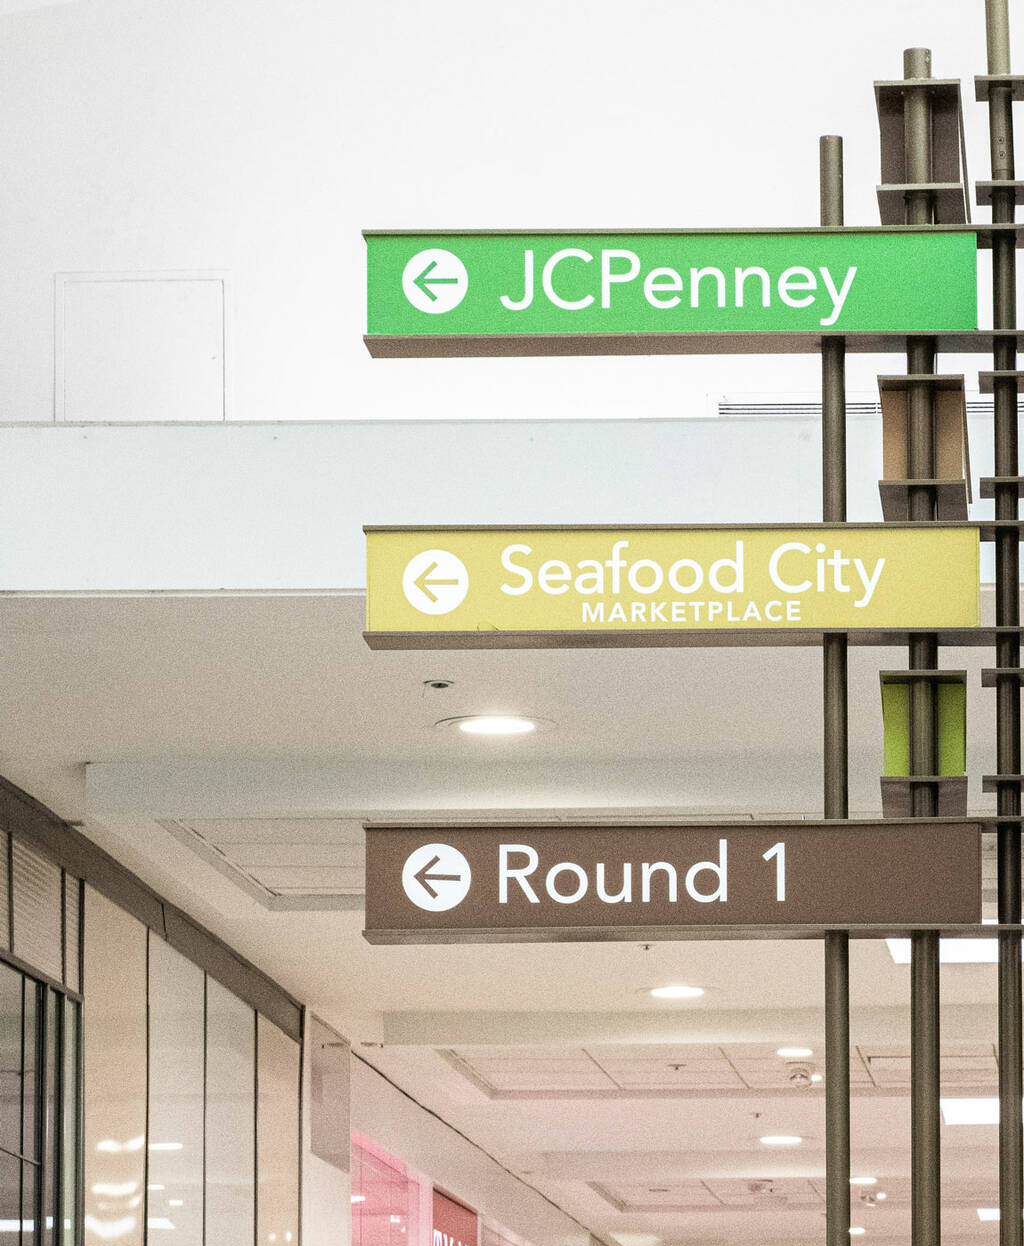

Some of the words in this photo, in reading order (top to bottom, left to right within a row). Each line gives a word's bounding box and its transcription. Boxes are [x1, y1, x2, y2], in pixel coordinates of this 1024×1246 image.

[499, 248, 858, 326] JCPenney
[500, 540, 745, 596] Seafood
[769, 541, 886, 609] City
[581, 600, 802, 623] MARKETPLACE
[499, 838, 728, 904] Round
[762, 842, 786, 902] 1
